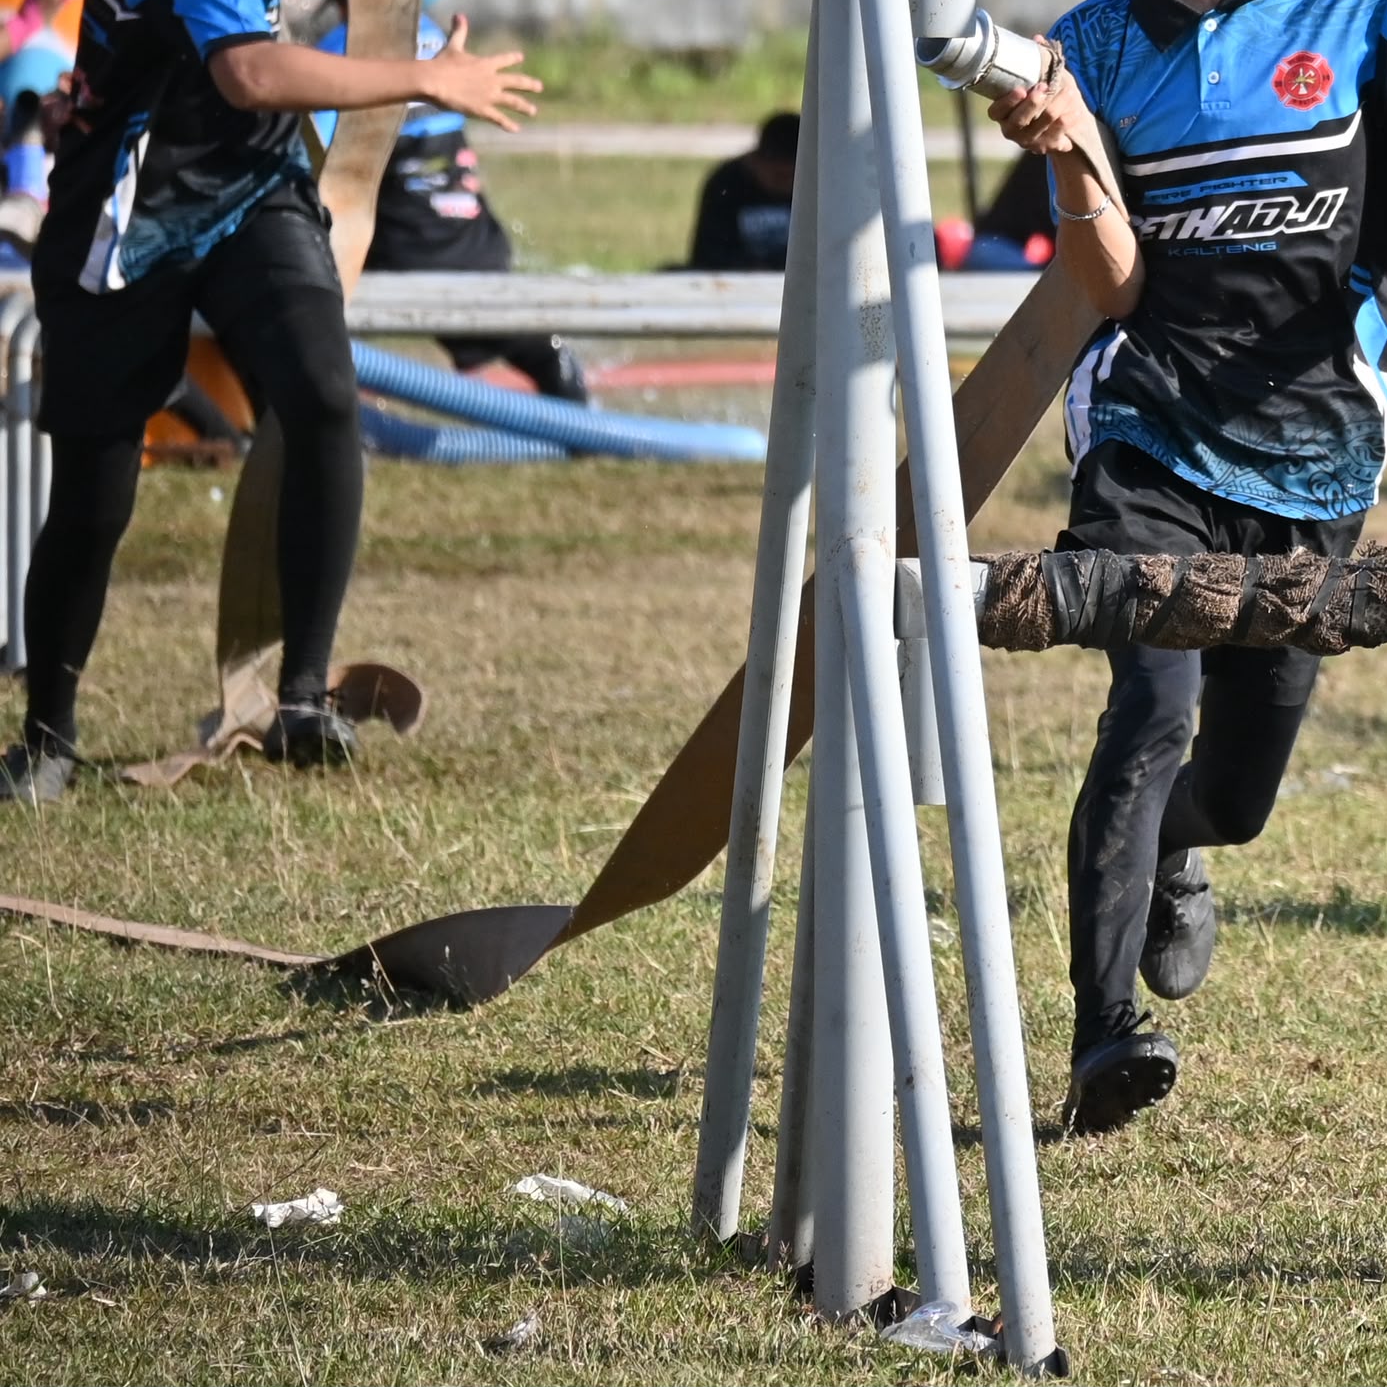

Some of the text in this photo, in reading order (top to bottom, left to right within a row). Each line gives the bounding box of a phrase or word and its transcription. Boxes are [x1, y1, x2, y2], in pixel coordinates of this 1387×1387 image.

[1150, 176, 1290, 202] FIRE FIGHTER
[1167, 241, 1279, 257] KALTENG
